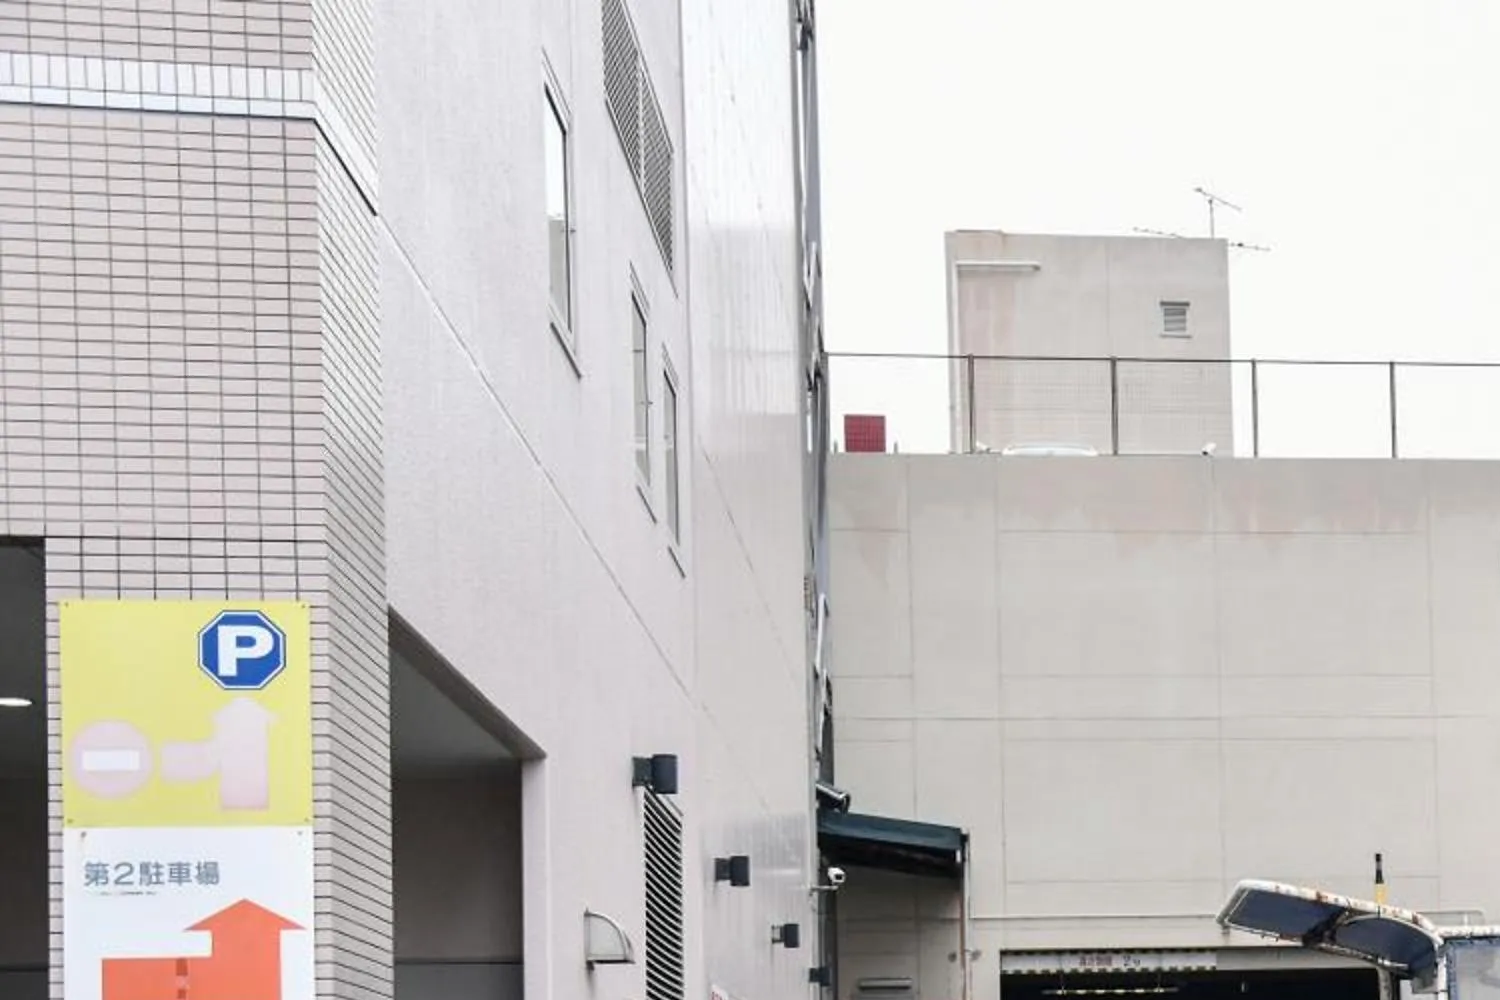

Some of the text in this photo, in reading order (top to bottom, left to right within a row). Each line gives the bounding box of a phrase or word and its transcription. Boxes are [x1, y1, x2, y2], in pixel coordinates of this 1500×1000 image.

[217, 625, 274, 677] P
[84, 861, 220, 886] 第2駐車場
